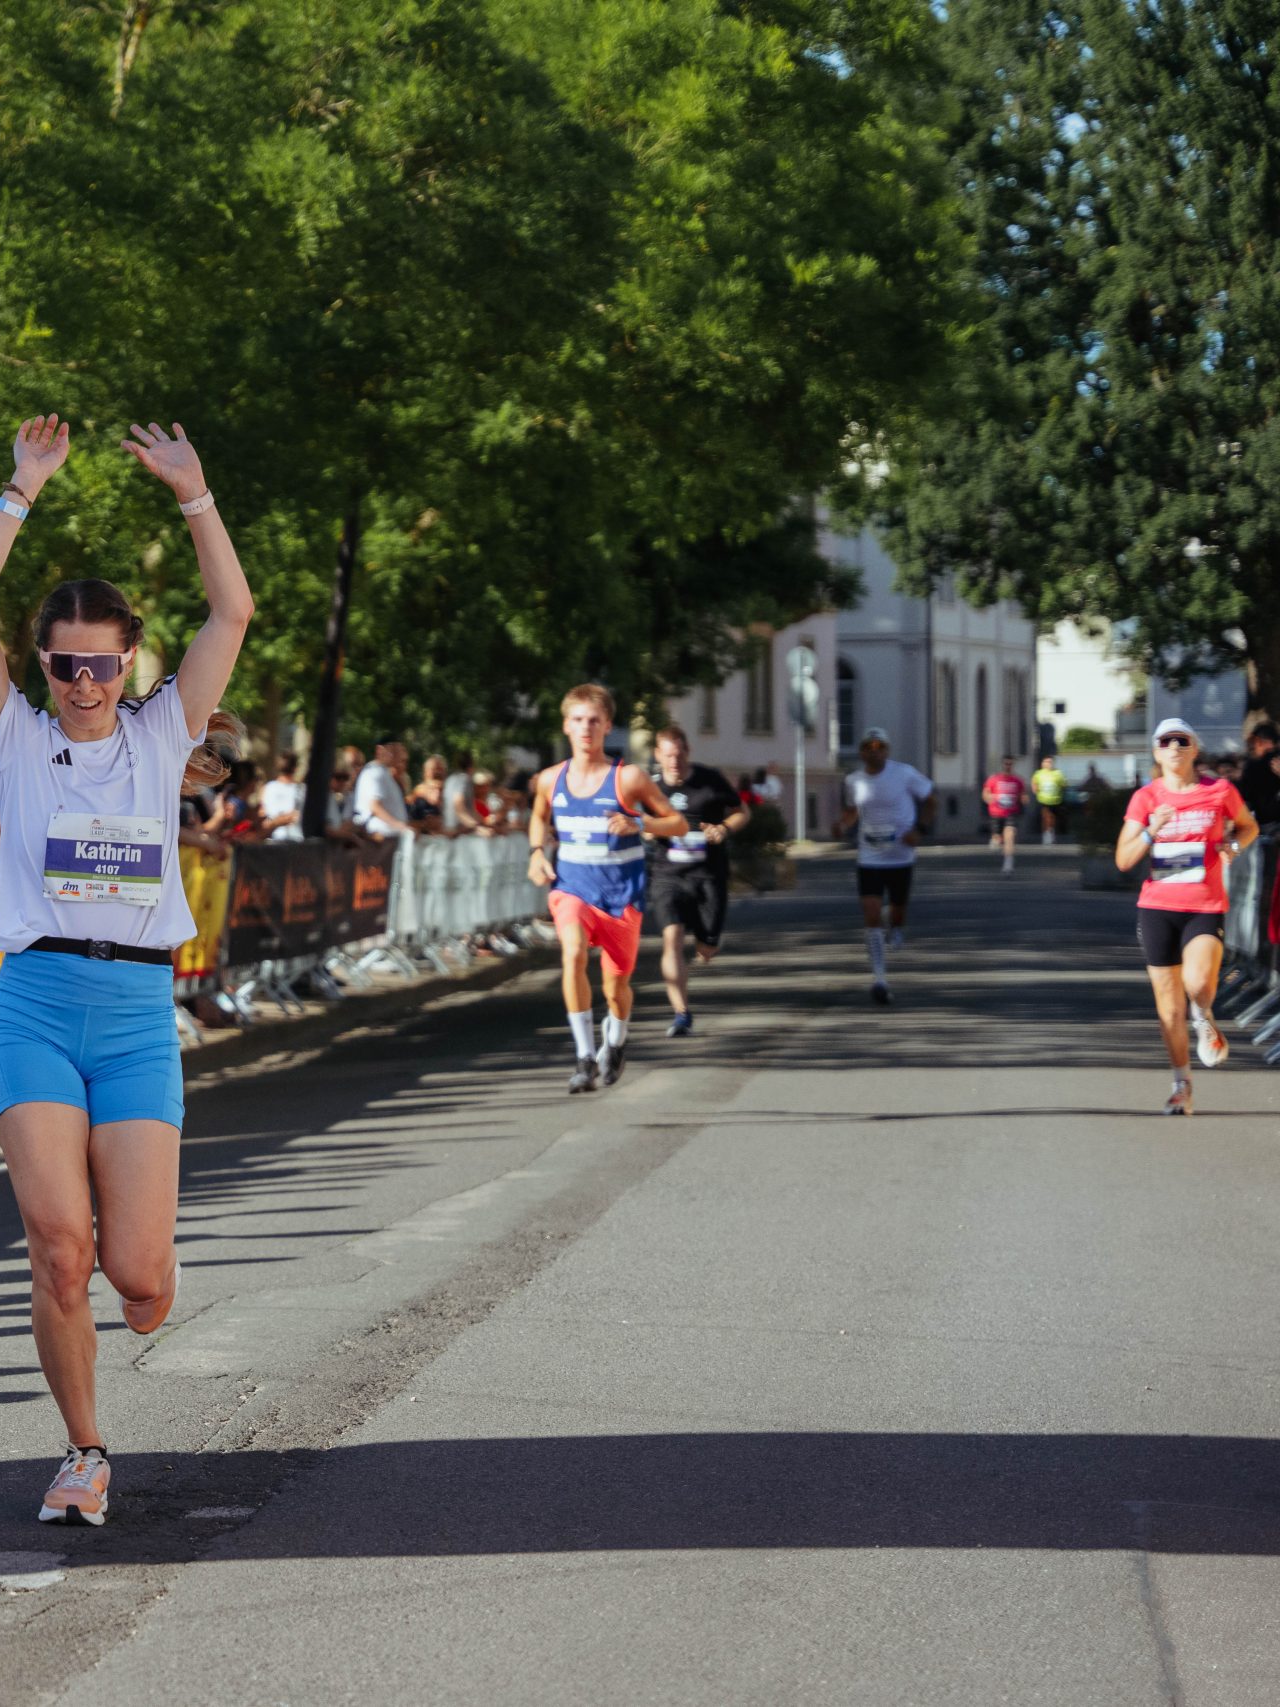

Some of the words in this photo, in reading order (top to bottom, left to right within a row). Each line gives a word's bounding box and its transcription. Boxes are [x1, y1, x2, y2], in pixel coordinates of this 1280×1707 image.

[75, 841, 142, 862] Kathrin
[94, 864, 120, 875] 4107
[62, 881, 79, 891] dm
